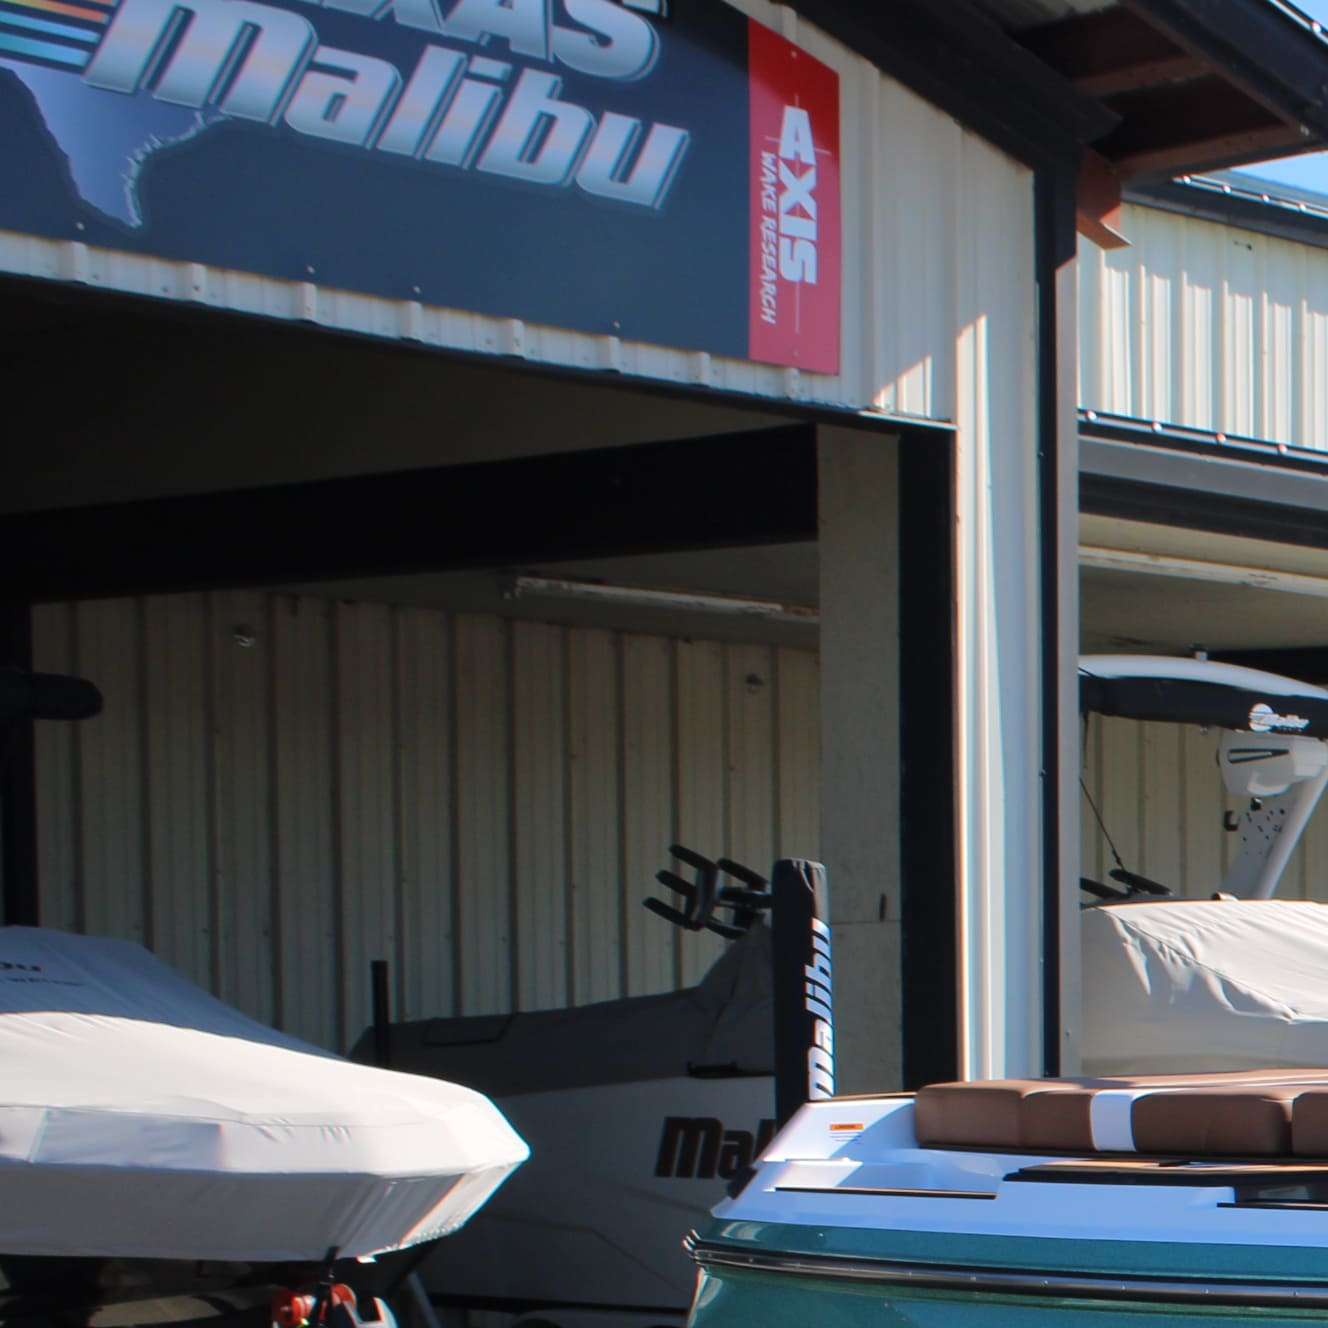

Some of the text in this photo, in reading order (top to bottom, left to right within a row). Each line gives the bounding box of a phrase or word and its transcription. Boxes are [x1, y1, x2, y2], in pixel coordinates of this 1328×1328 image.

[760, 151, 778, 325] WAKE RESEARCH
[778, 104, 817, 285] AXIS
[654, 1116, 777, 1179] Mal
